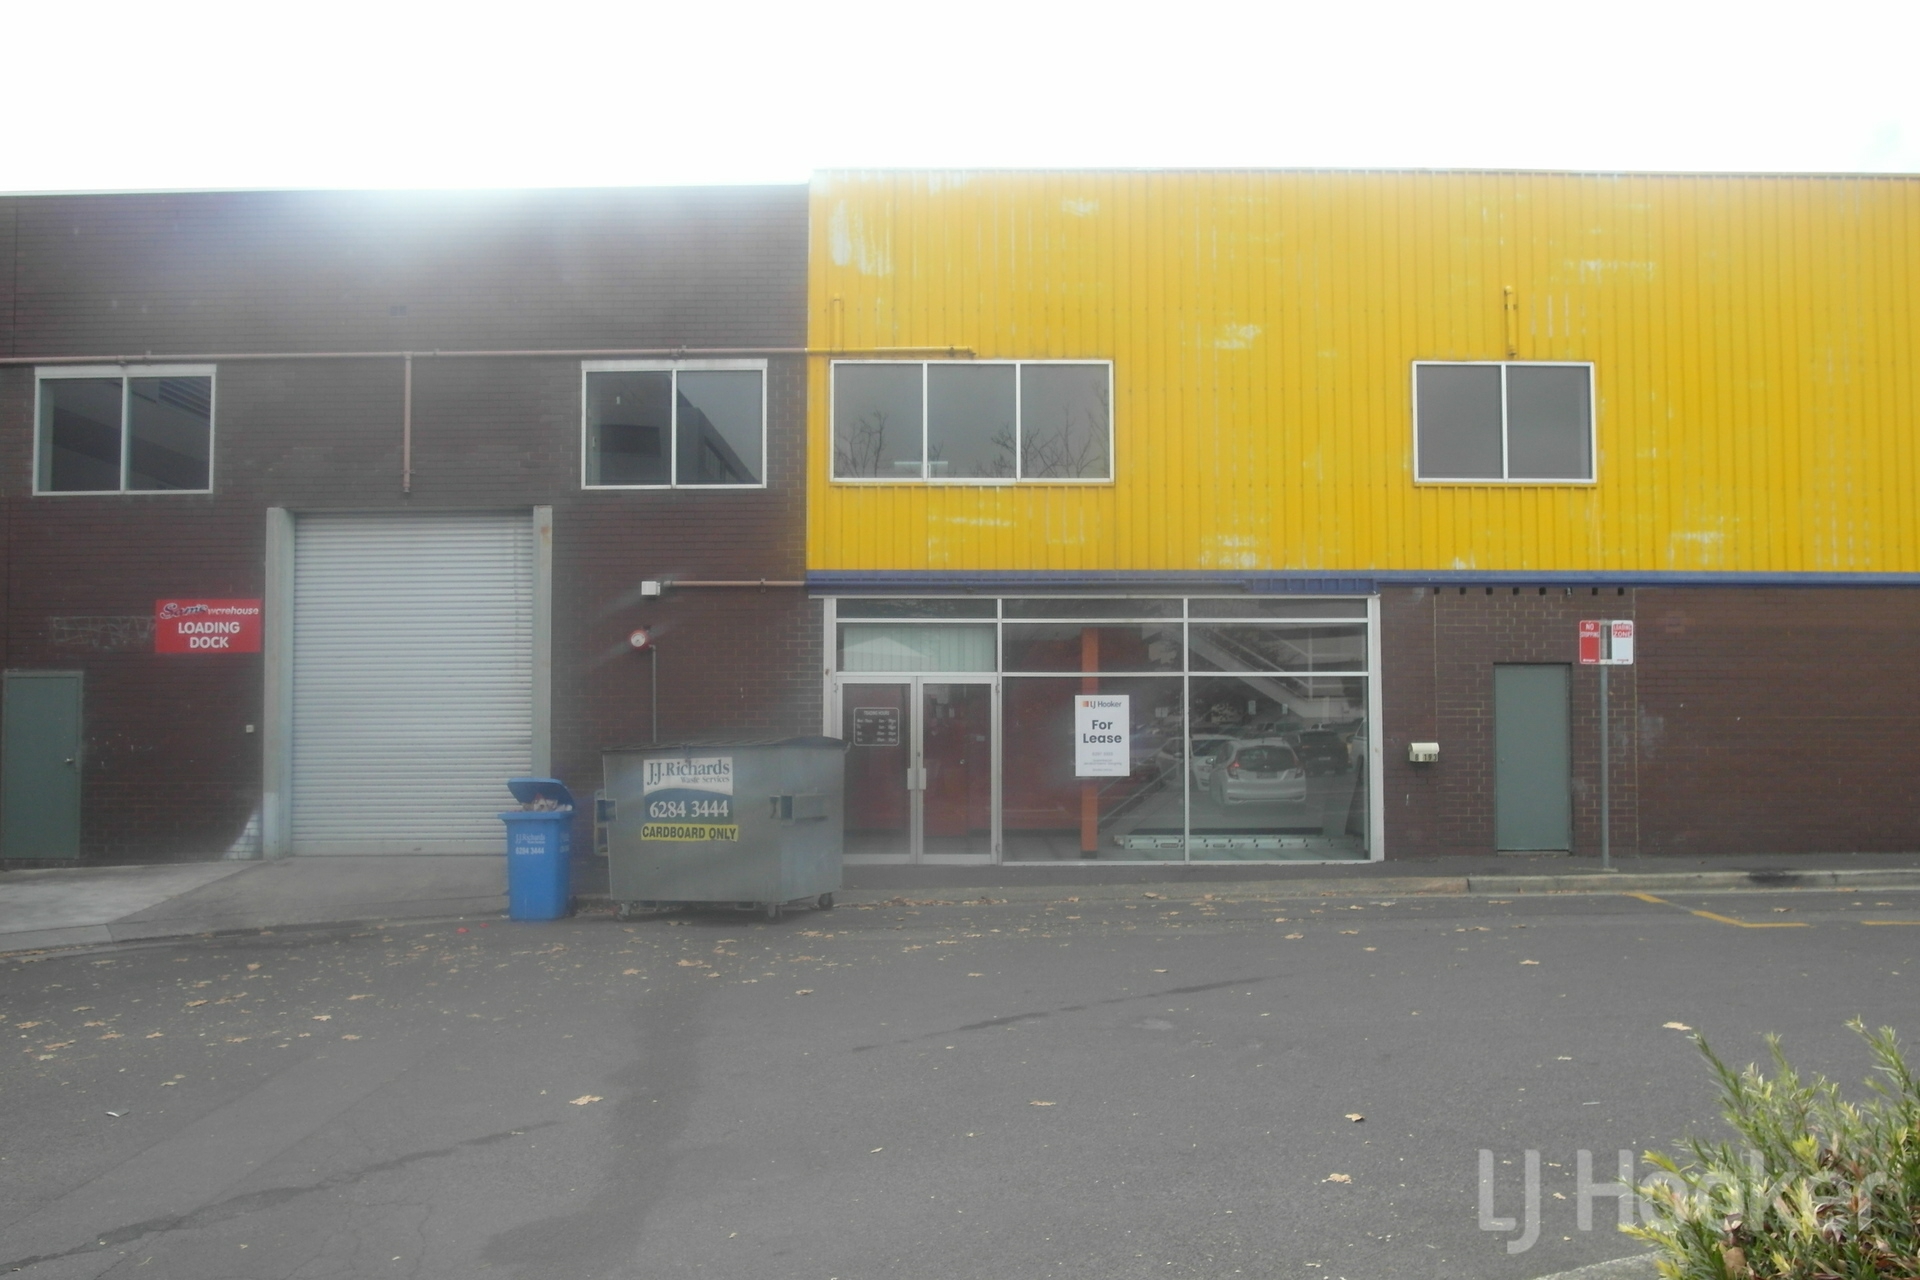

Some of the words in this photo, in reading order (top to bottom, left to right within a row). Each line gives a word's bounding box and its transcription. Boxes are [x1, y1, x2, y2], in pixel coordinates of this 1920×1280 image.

[208, 606, 259, 615] warehouse
[178, 622, 240, 634] LOADING
[1585, 623, 1595, 631] NO
[189, 637, 229, 649] DOCK
[1090, 701, 1096, 709] LJ
[1092, 720, 1113, 730] For
[1083, 733, 1122, 744] Lease
[702, 775, 730, 783] Services
[649, 800, 687, 818] 6284
[691, 800, 729, 818] 3444
[642, 825, 706, 839] CARDBOARD
[708, 827, 737, 840] ONLY
